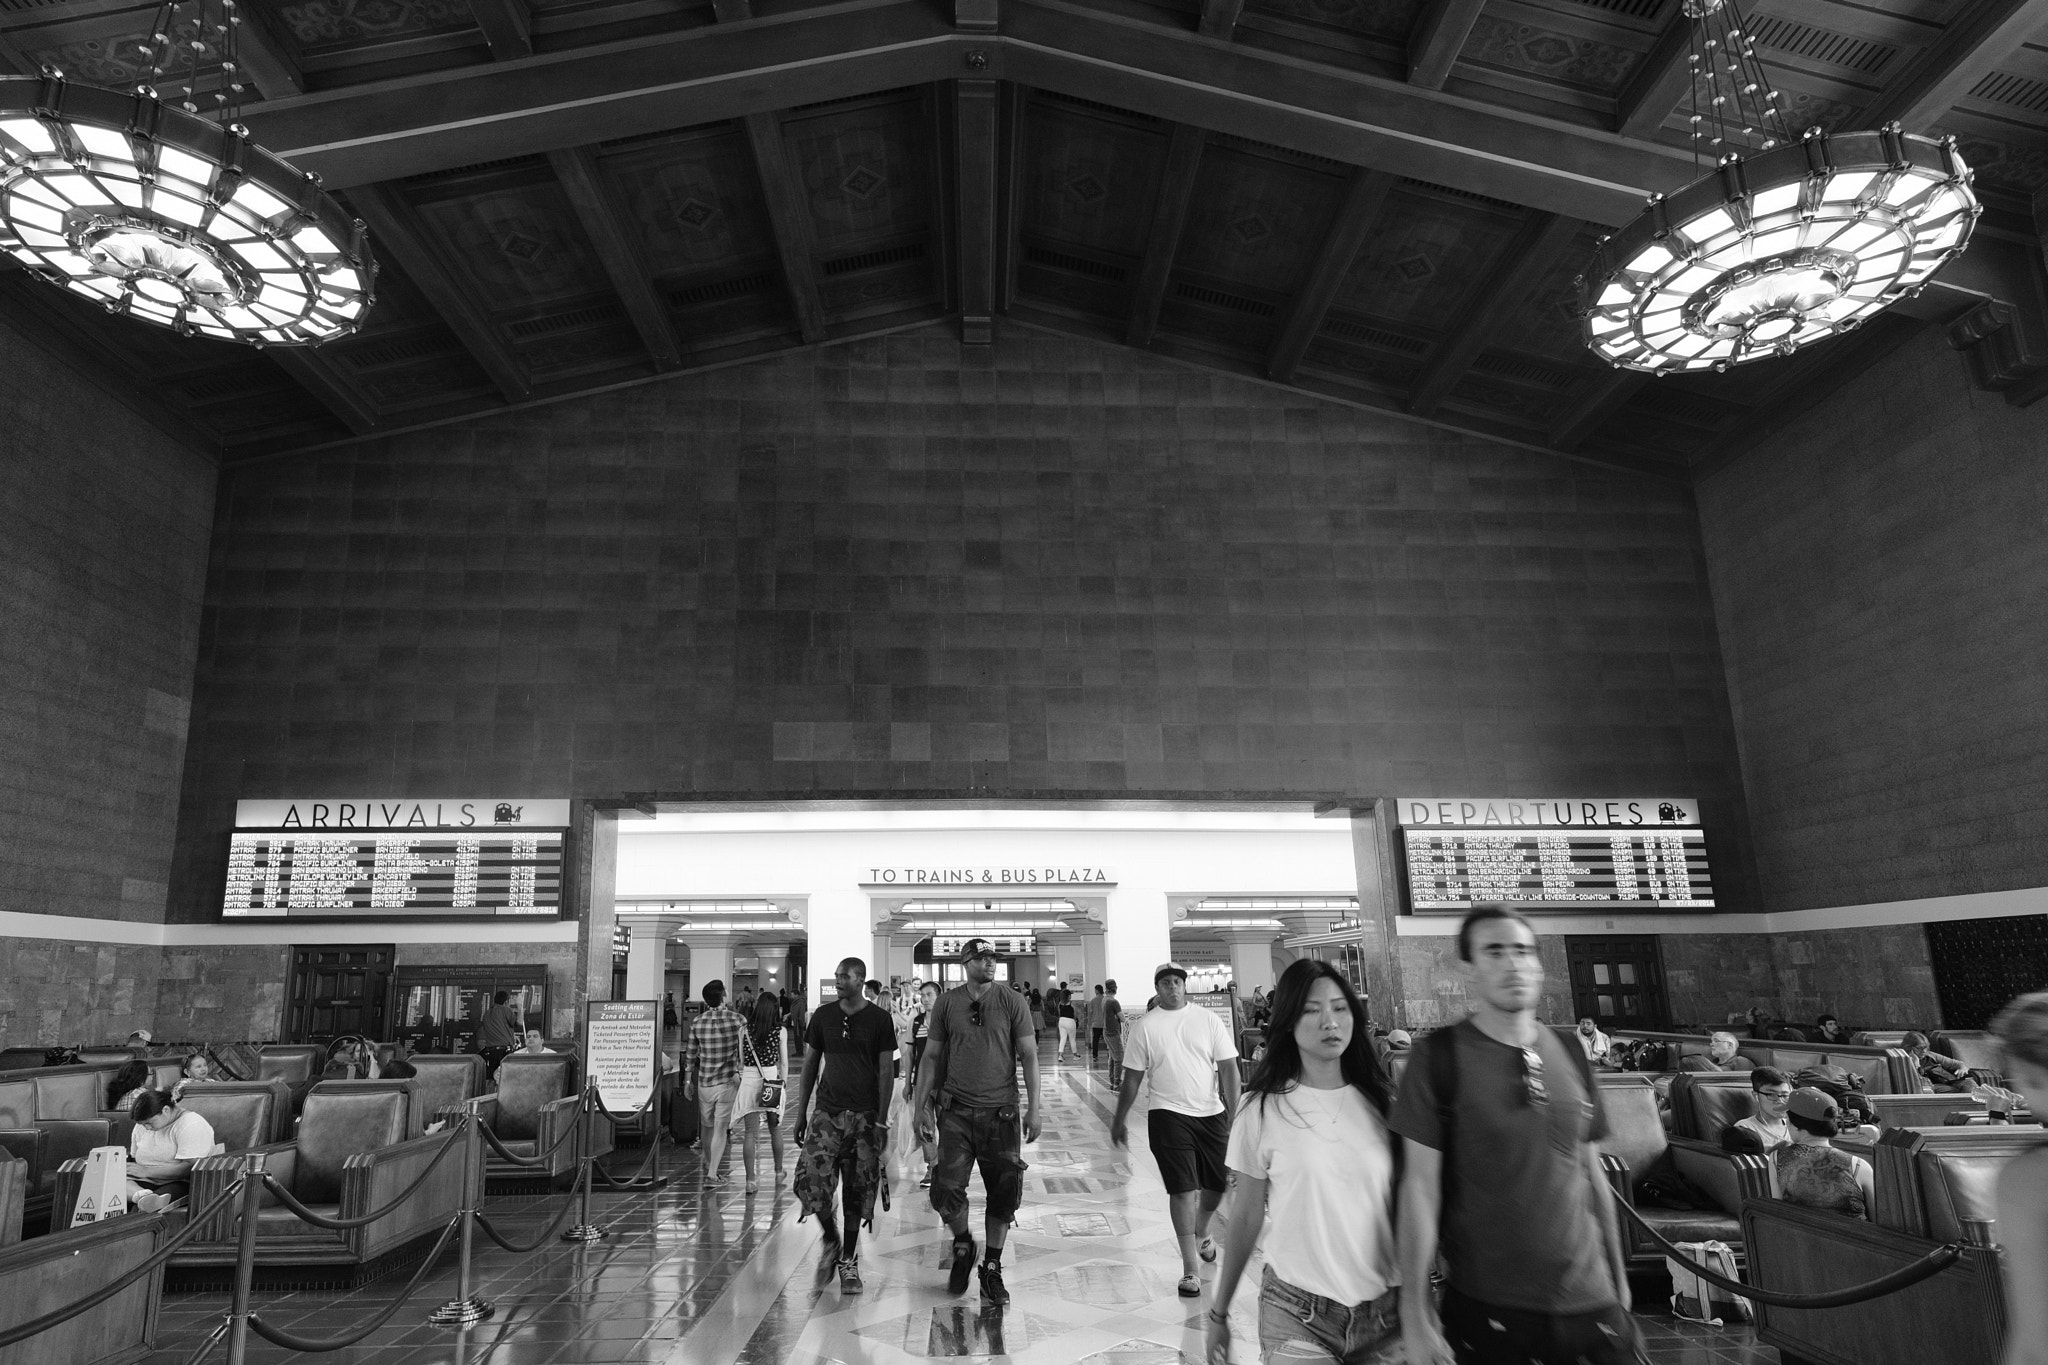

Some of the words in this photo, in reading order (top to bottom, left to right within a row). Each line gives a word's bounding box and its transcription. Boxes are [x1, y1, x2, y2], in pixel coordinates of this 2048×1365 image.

[282, 804, 476, 827] ARRIVALS
[1410, 802, 1643, 825] DEPARTURES
[870, 869, 896, 882] TO
[904, 869, 974, 882] TRAINS
[982, 869, 993, 882] &
[1002, 869, 1037, 882] BUS
[1045, 869, 1106, 882] PLAZA
[76, 1213, 96, 1221] CAUTION
[104, 1209, 124, 1218] CAUTION
